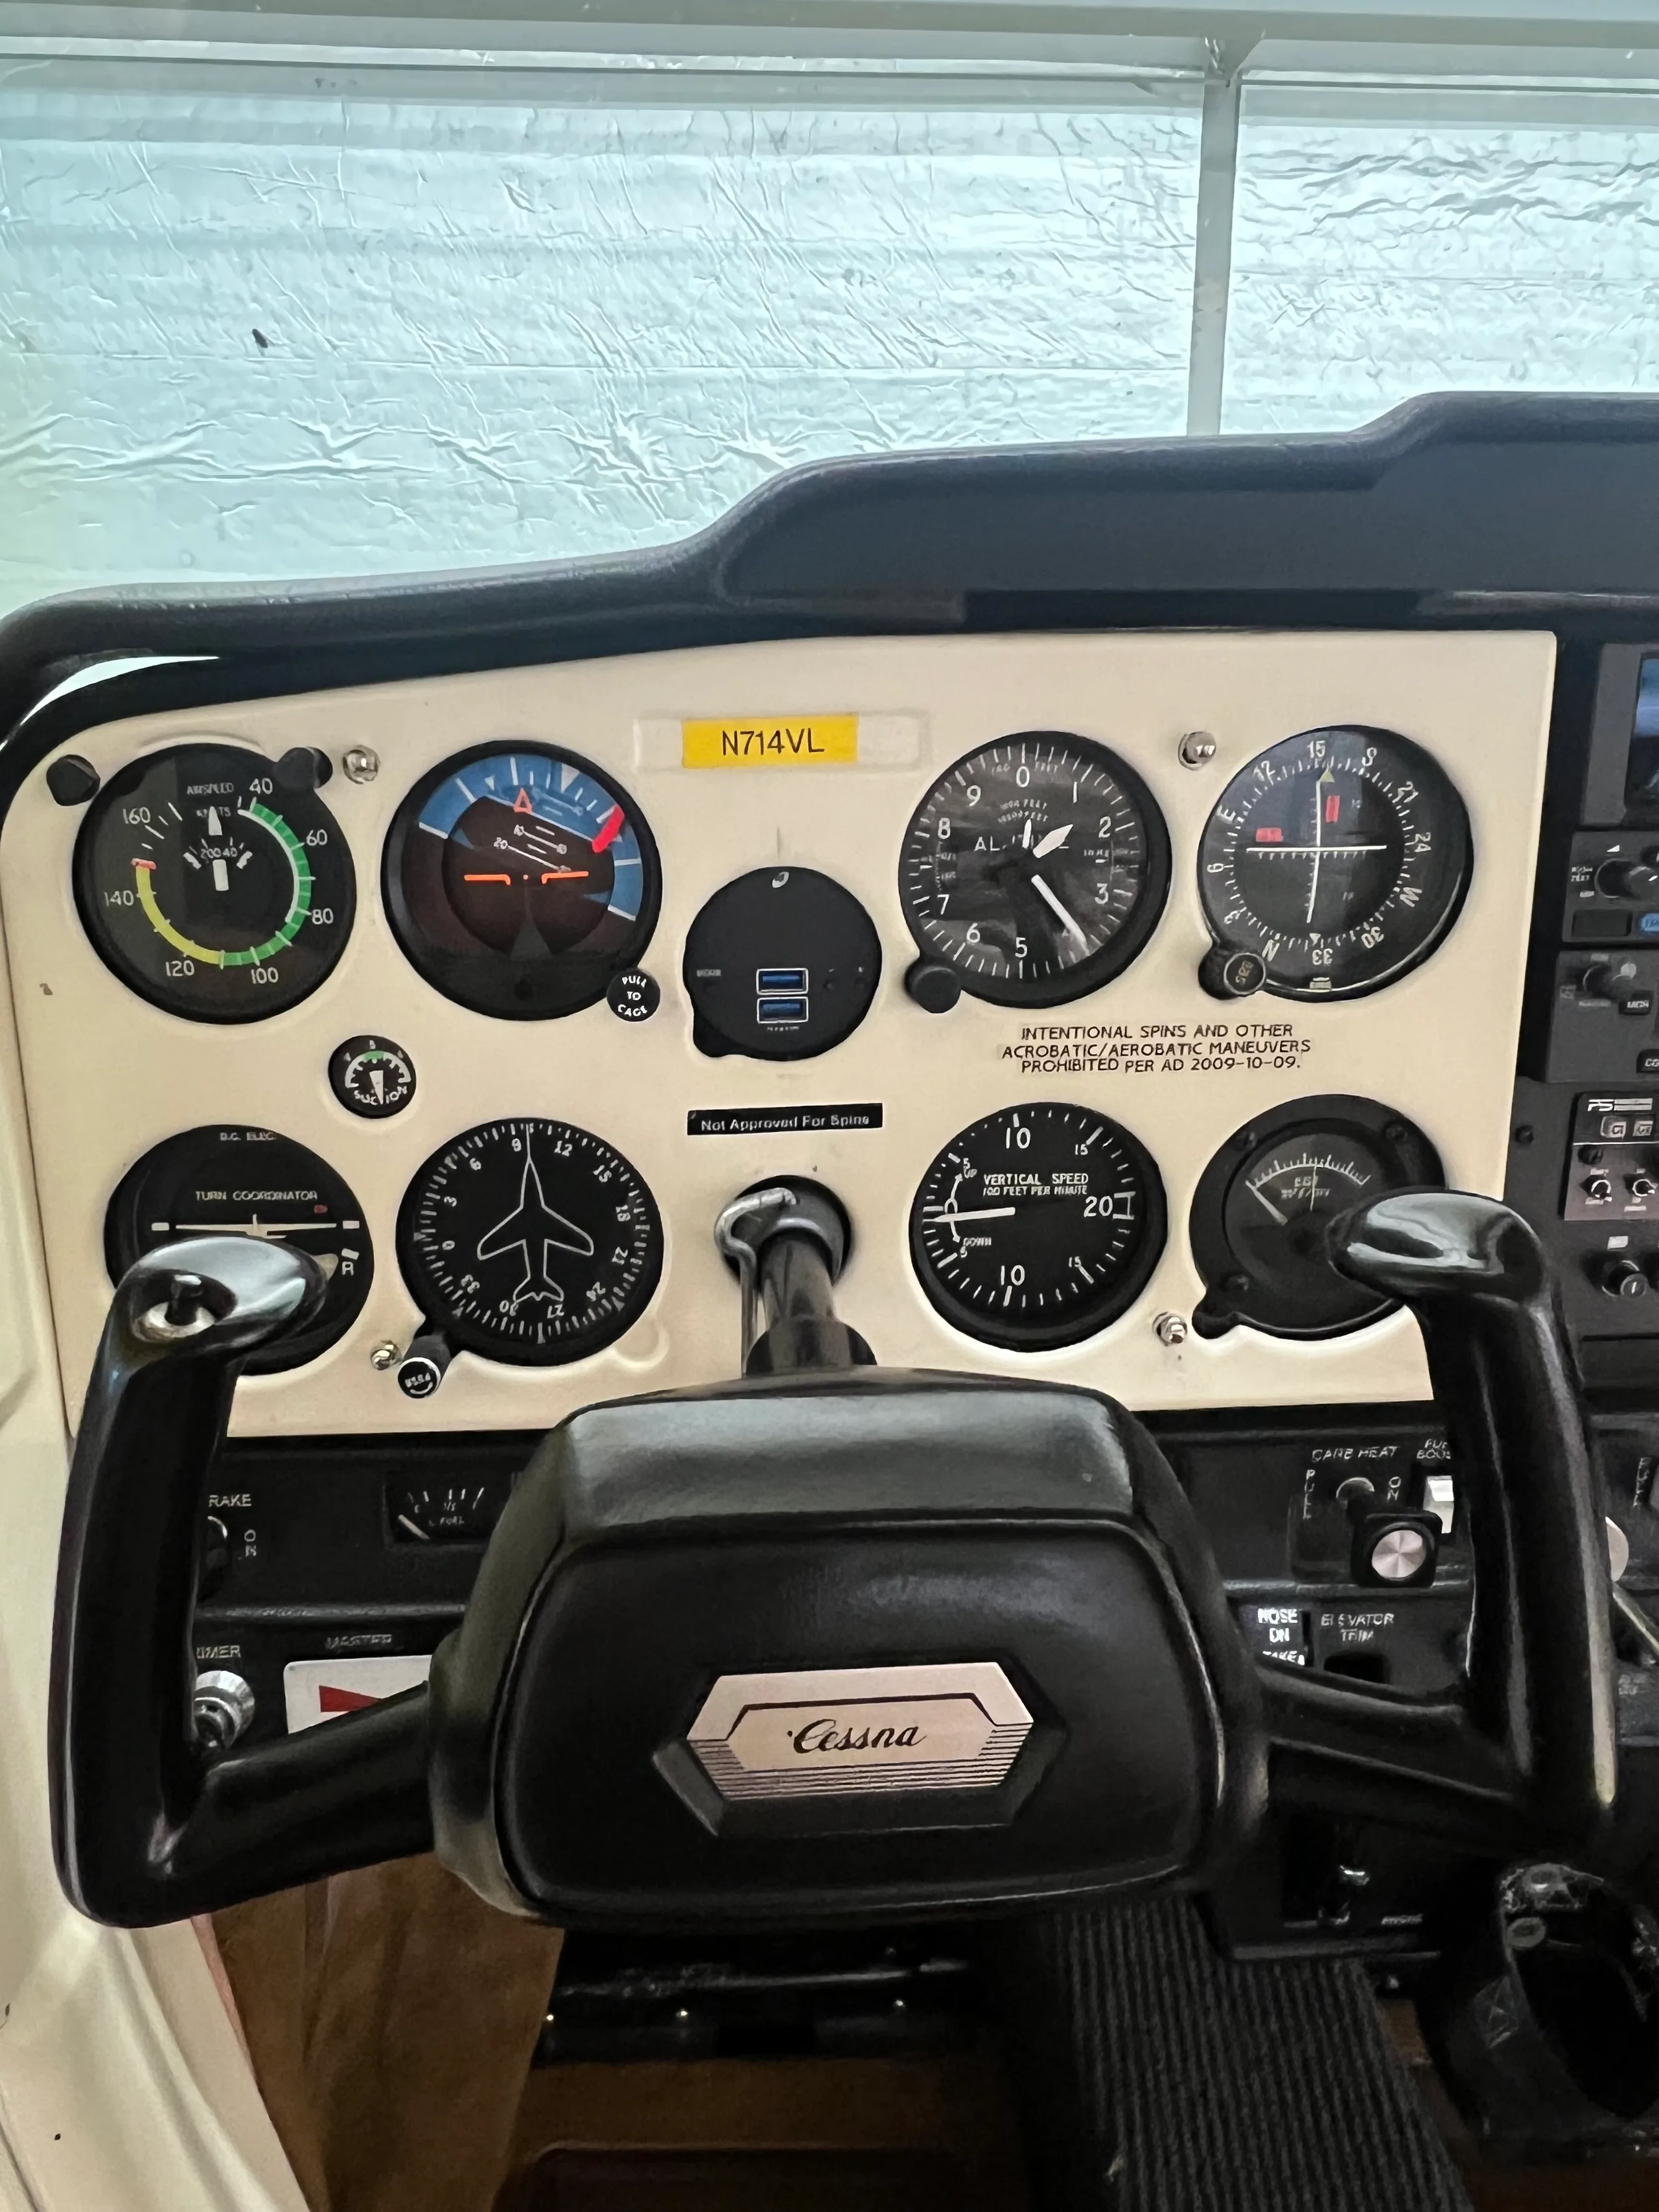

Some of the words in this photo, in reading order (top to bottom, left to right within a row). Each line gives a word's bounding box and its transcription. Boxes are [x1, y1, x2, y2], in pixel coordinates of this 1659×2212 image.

[722, 727, 824, 756] N714VL
[1306, 740, 1326, 759] 15
[1015, 765, 1030, 787] 0
[1253, 760, 1276, 782] 12
[249, 778, 273, 795] 40
[1073, 781, 1078, 803] 1
[966, 785, 982, 807] 9
[122, 807, 151, 824] 160
[938, 817, 951, 839] 8
[1098, 816, 1111, 838] 2
[306, 829, 328, 846] 60
[104, 891, 134, 907] 140
[1095, 883, 1109, 905] 3
[1400, 886, 1422, 907] W
[937, 894, 949, 915] 7
[312, 909, 334, 925] 80
[966, 923, 981, 944] 6
[1361, 927, 1384, 949] 30
[1015, 937, 1028, 958] 5
[1262, 939, 1281, 962] N
[1312, 948, 1334, 966] 33
[165, 960, 195, 977] 120
[251, 967, 279, 984] 100
[627, 991, 642, 1001] TO
[618, 1004, 647, 1017] CAGE
[1021, 1026, 1133, 1041] INTENTIONAL
[1140, 1025, 1187, 1039] SPINS
[1194, 1025, 1229, 1039] AND
[1235, 1023, 1294, 1038] OTHER
[1002, 1042, 1203, 1060] ACROBATIC/AEROBATIC
[1209, 1040, 1312, 1055] MANEUVERS
[1021, 1059, 1120, 1074] PROHIBITED
[1125, 1060, 1154, 1074] PER
[1161, 1059, 1185, 1072] AD
[1190, 1056, 1301, 1072] 2009-10-09.
[353, 1086, 408, 1106] SUCION
[701, 1120, 726, 1132] Not
[730, 1116, 798, 1132] Approved
[802, 1115, 826, 1128] For
[1005, 1127, 1031, 1150] 10
[554, 1141, 574, 1157] 12
[1074, 1144, 1089, 1156] 15
[593, 1164, 612, 1183] 15
[983, 1173, 1042, 1185] VERTICAL
[1052, 1173, 1089, 1185] SPEED
[1003, 1186, 1028, 1196] FEET
[1030, 1185, 1051, 1196] PER
[1084, 1195, 1113, 1217] 20
[1069, 1256, 1082, 1268] 15
[1001, 1264, 1025, 1286] 10
[1358, 1445, 1402, 1459] HEAT
[208, 1493, 252, 1508] RAKE
[1257, 1608, 1299, 1625] NOSE
[1320, 1612, 1395, 1627] ELEVATOR
[787, 1718, 927, 1753] Cessna
